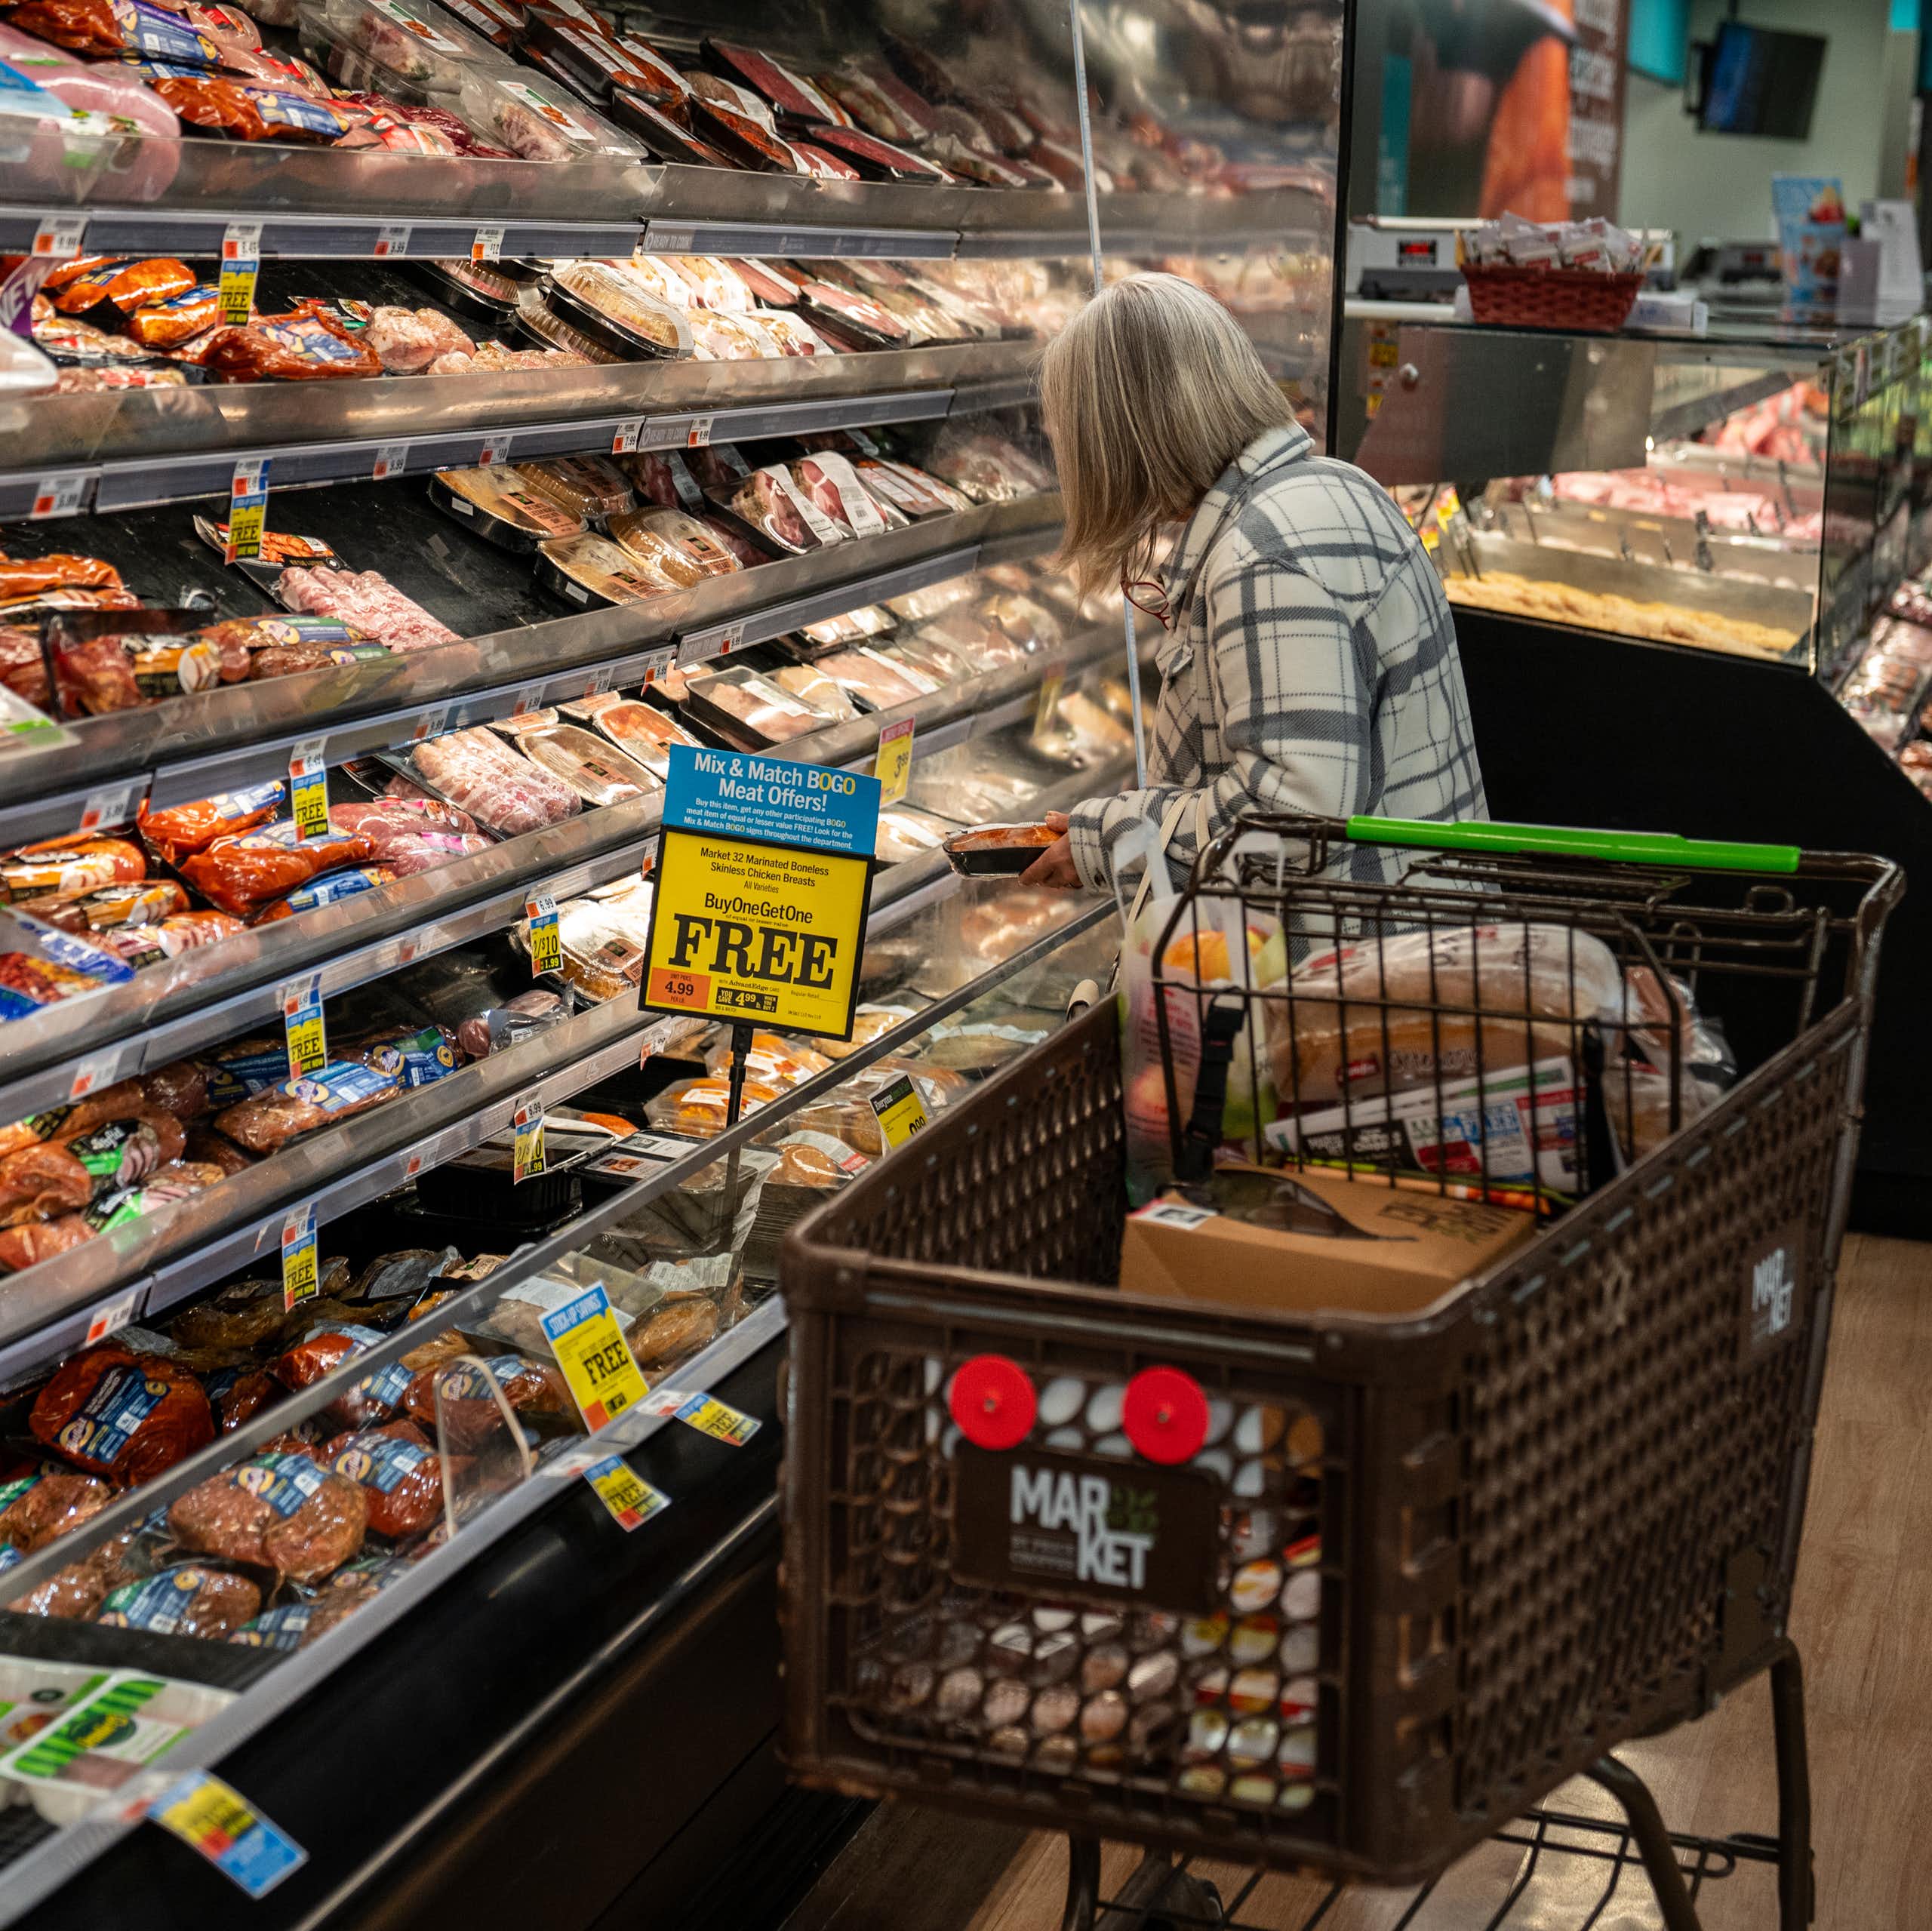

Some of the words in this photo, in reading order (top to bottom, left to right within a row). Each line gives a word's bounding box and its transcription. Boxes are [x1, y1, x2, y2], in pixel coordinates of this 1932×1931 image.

[220, 292, 249, 309] FREE
[230, 525, 258, 543] FREE
[694, 752, 726, 775] Mix
[728, 758, 743, 777] &
[748, 761, 802, 786] Match
[807, 770, 856, 795] BOGO
[718, 779, 764, 803] Meat
[768, 786, 827, 812] Offers!
[296, 802, 324, 824] FREE
[686, 807, 703, 816] meat
[704, 808, 718, 818] item
[720, 810, 728, 819] of
[728, 812, 746, 823] equal
[755, 815, 774, 826] lesser
[775, 819, 793, 830] value
[793, 823, 814, 834] FREE!
[814, 826, 830, 836] Look
[831, 829, 841, 838] for
[841, 830, 853, 839] the
[695, 798, 708, 809] Buy
[709, 800, 721, 810] this
[722, 801, 739, 813] item,
[740, 804, 752, 814] get
[752, 807, 764, 817] any
[765, 808, 783, 818] other
[783, 811, 826, 826] participating
[826, 818, 846, 829] BOGO
[683, 816, 696, 825] Mix
[703, 819, 724, 829] Match
[725, 822, 745, 832] BOGO
[746, 826, 763, 837] signs
[764, 827, 800, 842] throughout
[801, 834, 812, 843] the
[813, 836, 853, 850] department.
[700, 847, 731, 861] Market
[732, 851, 743, 862] 32
[746, 854, 789, 870] Marinated
[791, 861, 829, 876] Boneless
[710, 862, 746, 876] Skinless
[747, 869, 781, 882] Chicken
[783, 874, 816, 887] Breasts
[743, 881, 752, 889] All
[753, 882, 779, 893] Varieties
[540, 898, 554, 911] 6.99
[704, 893, 813, 924] BuyOneGetOne
[534, 935, 558, 960] 2/$10
[668, 913, 838, 990] FREE
[545, 958, 559, 969] 1.99
[665, 980, 694, 997] 4.99
[729, 979, 769, 992] AdvantEdge
[718, 995, 731, 1004] SAVE
[290, 1037, 320, 1062] FREE
[529, 1102, 542, 1115] 6.99
[287, 1264, 312, 1290] FREE
[582, 1340, 629, 1385] FREE
[705, 1410, 738, 1437] FREE
[608, 1483, 646, 1512] FREE
